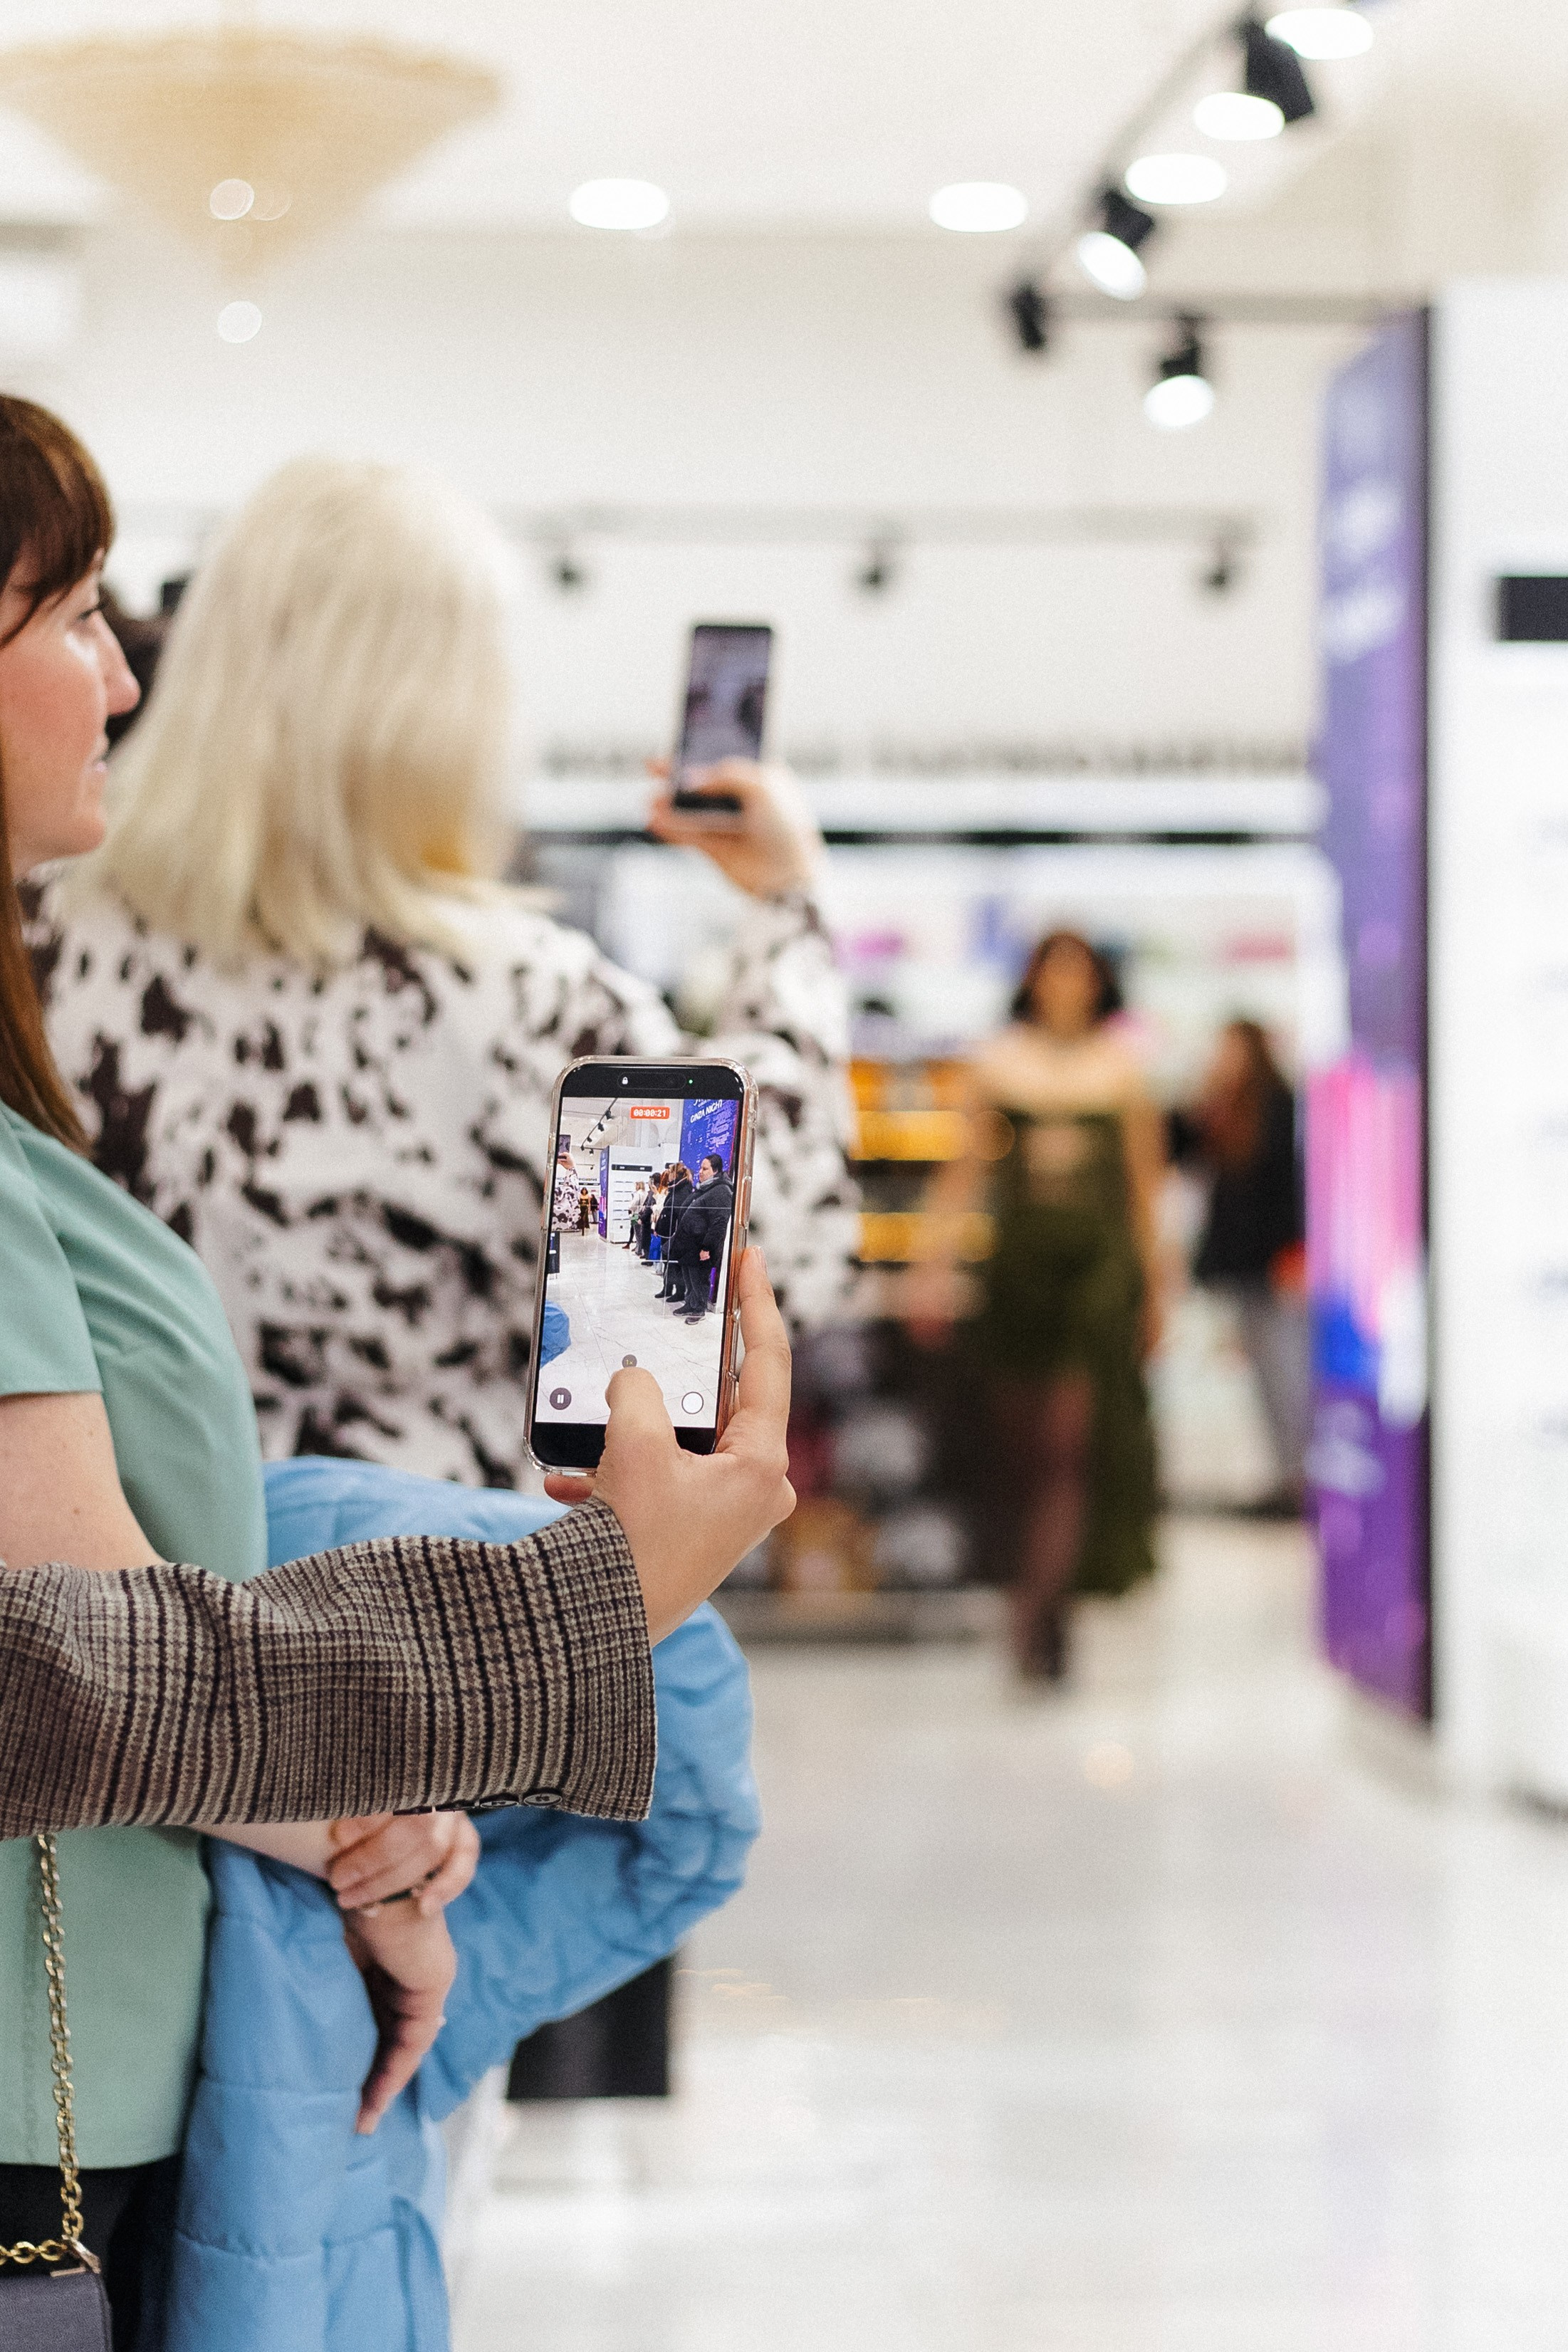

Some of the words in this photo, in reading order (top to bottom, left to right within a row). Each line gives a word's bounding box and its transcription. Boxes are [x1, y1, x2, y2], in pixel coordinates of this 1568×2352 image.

[633, 1109, 667, 1117] 00:00:21
[690, 1109, 705, 1123] GINZA
[706, 1099, 723, 1115] NIGHT
